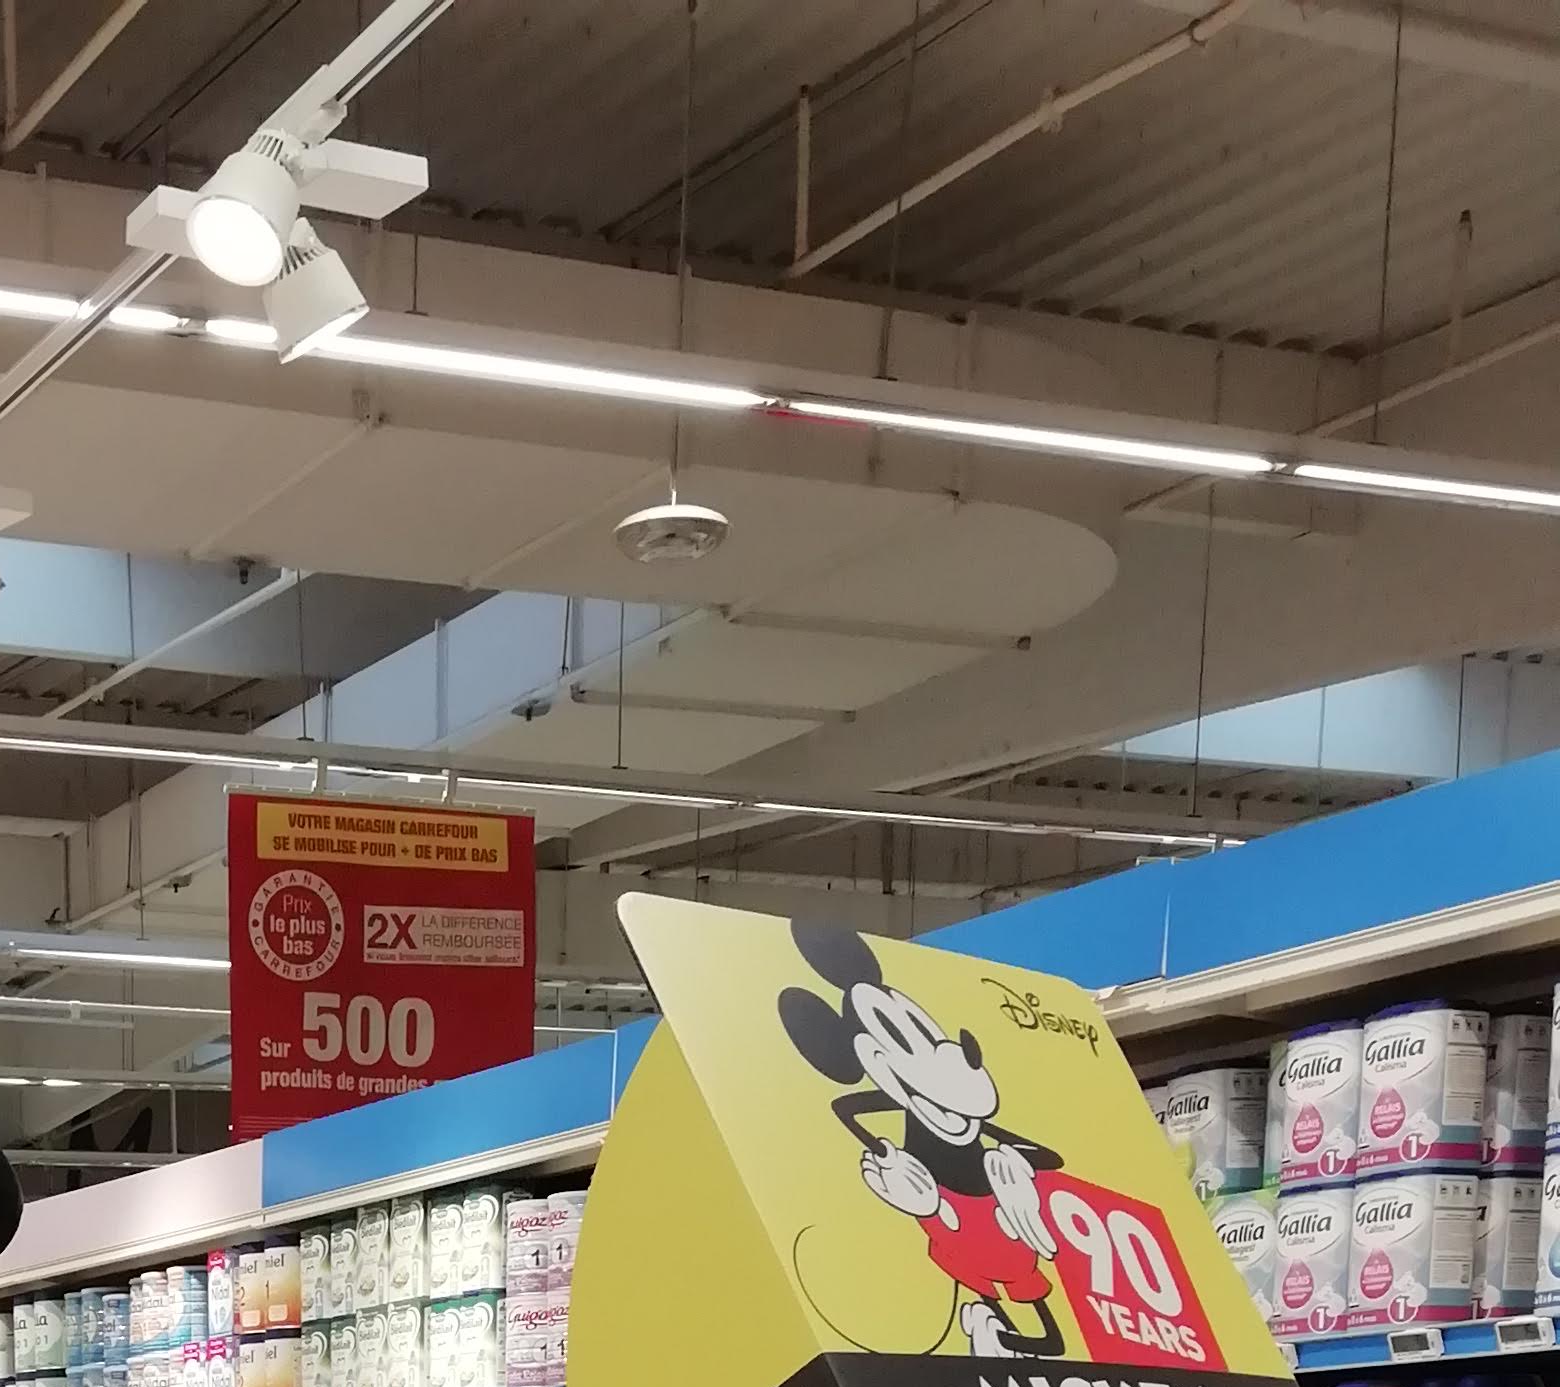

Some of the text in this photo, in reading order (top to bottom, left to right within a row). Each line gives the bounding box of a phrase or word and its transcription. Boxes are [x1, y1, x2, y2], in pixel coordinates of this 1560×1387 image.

[288, 813, 478, 840] VOTRE MAGASIN CARREFOUR
[273, 836, 290, 851] SE
[294, 837, 356, 854] MOBILISE
[361, 841, 396, 858] POUR
[414, 844, 432, 859] DE
[436, 845, 466, 862] PRIX
[471, 847, 497, 863] BAS
[255, 873, 339, 913] GARANTIE
[283, 894, 312, 914] Prix
[270, 916, 326, 938] le plus
[367, 914, 418, 950] 2X
[422, 916, 437, 930] LA
[254, 937, 340, 979] CARREFOUR
[283, 937, 313, 956] bas
[303, 991, 435, 1068] 500
[260, 1037, 291, 1058] Sur
[1365, 1037, 1425, 1066] Gallia
[261, 1068, 332, 1092] produits
[337, 1072, 354, 1092] de
[1288, 1055, 1343, 1083] Gallia
[1168, 1094, 1209, 1119] Gallia
[1408, 1135, 1417, 1158] 1
[1326, 1150, 1335, 1173] 1
[1278, 1214, 1332, 1239] Gallia
[1355, 1201, 1413, 1227] Gallia
[1049, 1190, 1182, 1317] 90
[1316, 1308, 1325, 1329] 1
[1396, 1298, 1405, 1320] 1
[1086, 1295, 1206, 1363] YEARS
